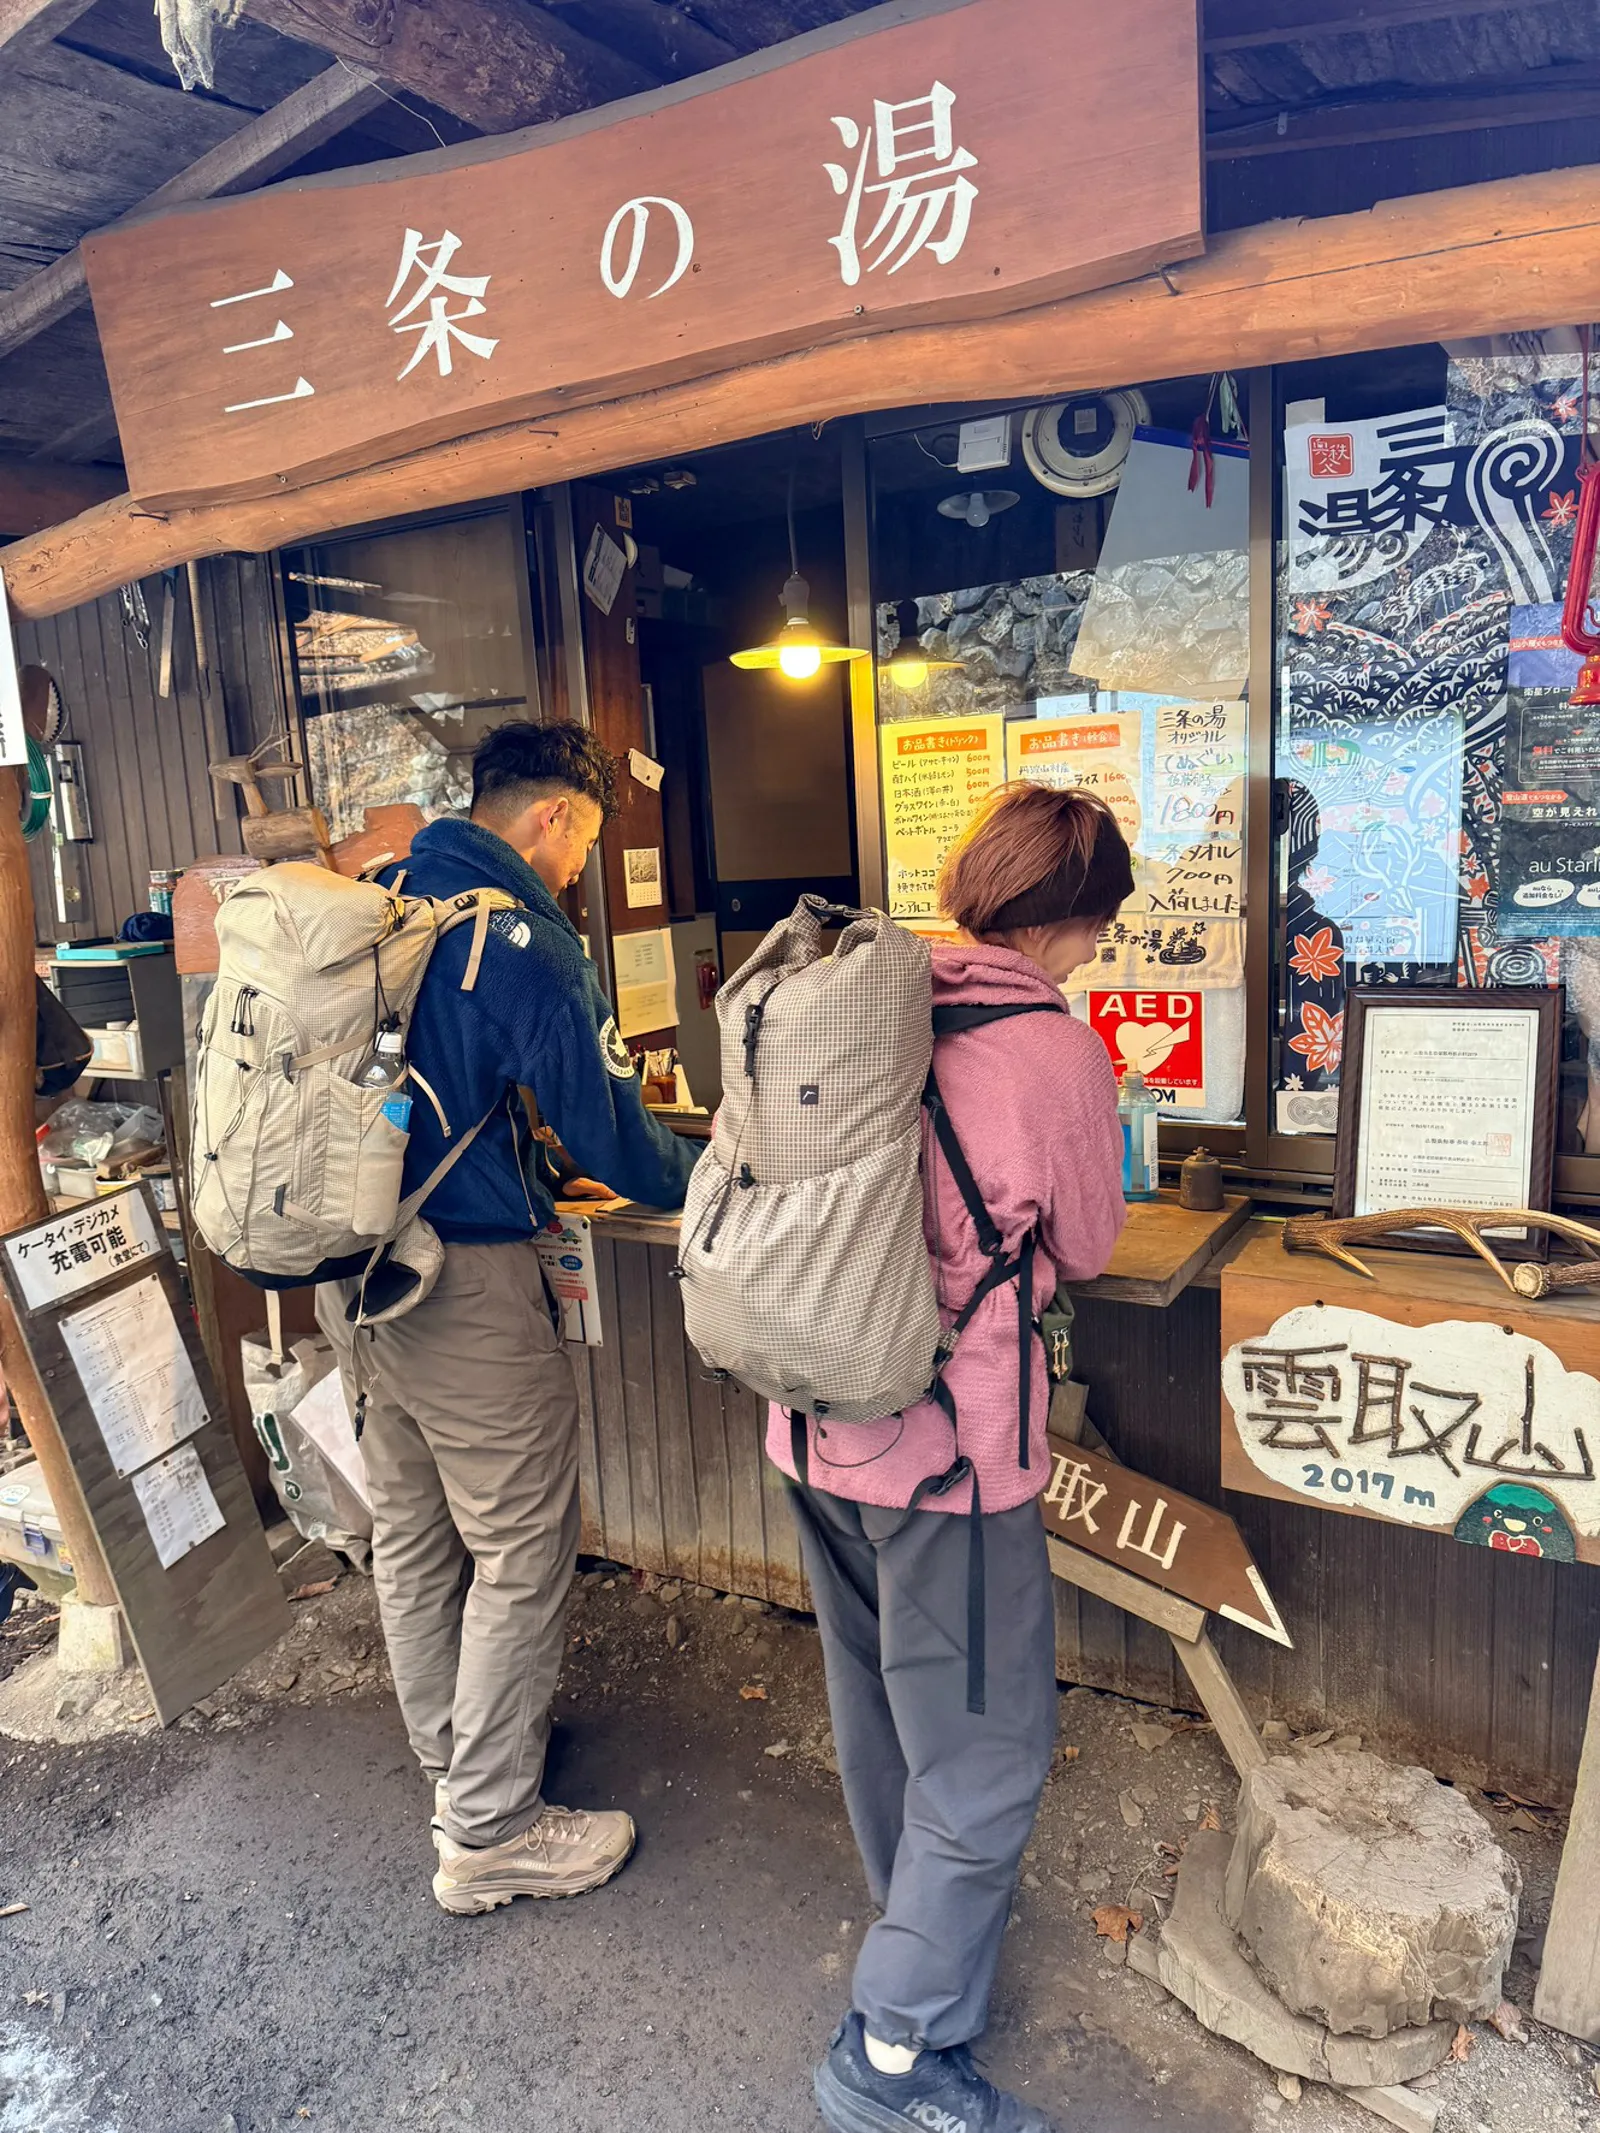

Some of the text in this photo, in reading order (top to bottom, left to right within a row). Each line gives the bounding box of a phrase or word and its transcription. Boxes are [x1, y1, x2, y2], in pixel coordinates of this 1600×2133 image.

[210, 80, 980, 413] 三条の湯
[1311, 437, 1351, 476] 奥秩父
[1297, 414, 1456, 582] 三条の湯
[1159, 704, 1227, 729] 三条の湯
[1168, 730, 1226, 744] オリジナル
[966, 753, 990, 763] 600円
[1158, 748, 1233, 774] てぬぐい
[966, 767, 990, 777] 500円
[1037, 774, 1099, 787] カレーライス
[966, 780, 990, 791] 600円
[1160, 794, 1235, 825] 1800円
[898, 868, 938, 879] ホットココ
[1166, 867, 1233, 885] 700円
[1529, 859, 1551, 873] au
[1148, 887, 1241, 914] 入荷しました
[1096, 921, 1163, 952] 三条の湯
[1098, 993, 1194, 1019] AED
[17, 1204, 120, 1259] ケータイ・デジカメ
[49, 1225, 127, 1275] 充電可能
[1241, 1343, 1596, 1480] 雲取山
[1301, 1463, 1436, 1508] 2017 m
[902, 2097, 967, 2133] HOKA
